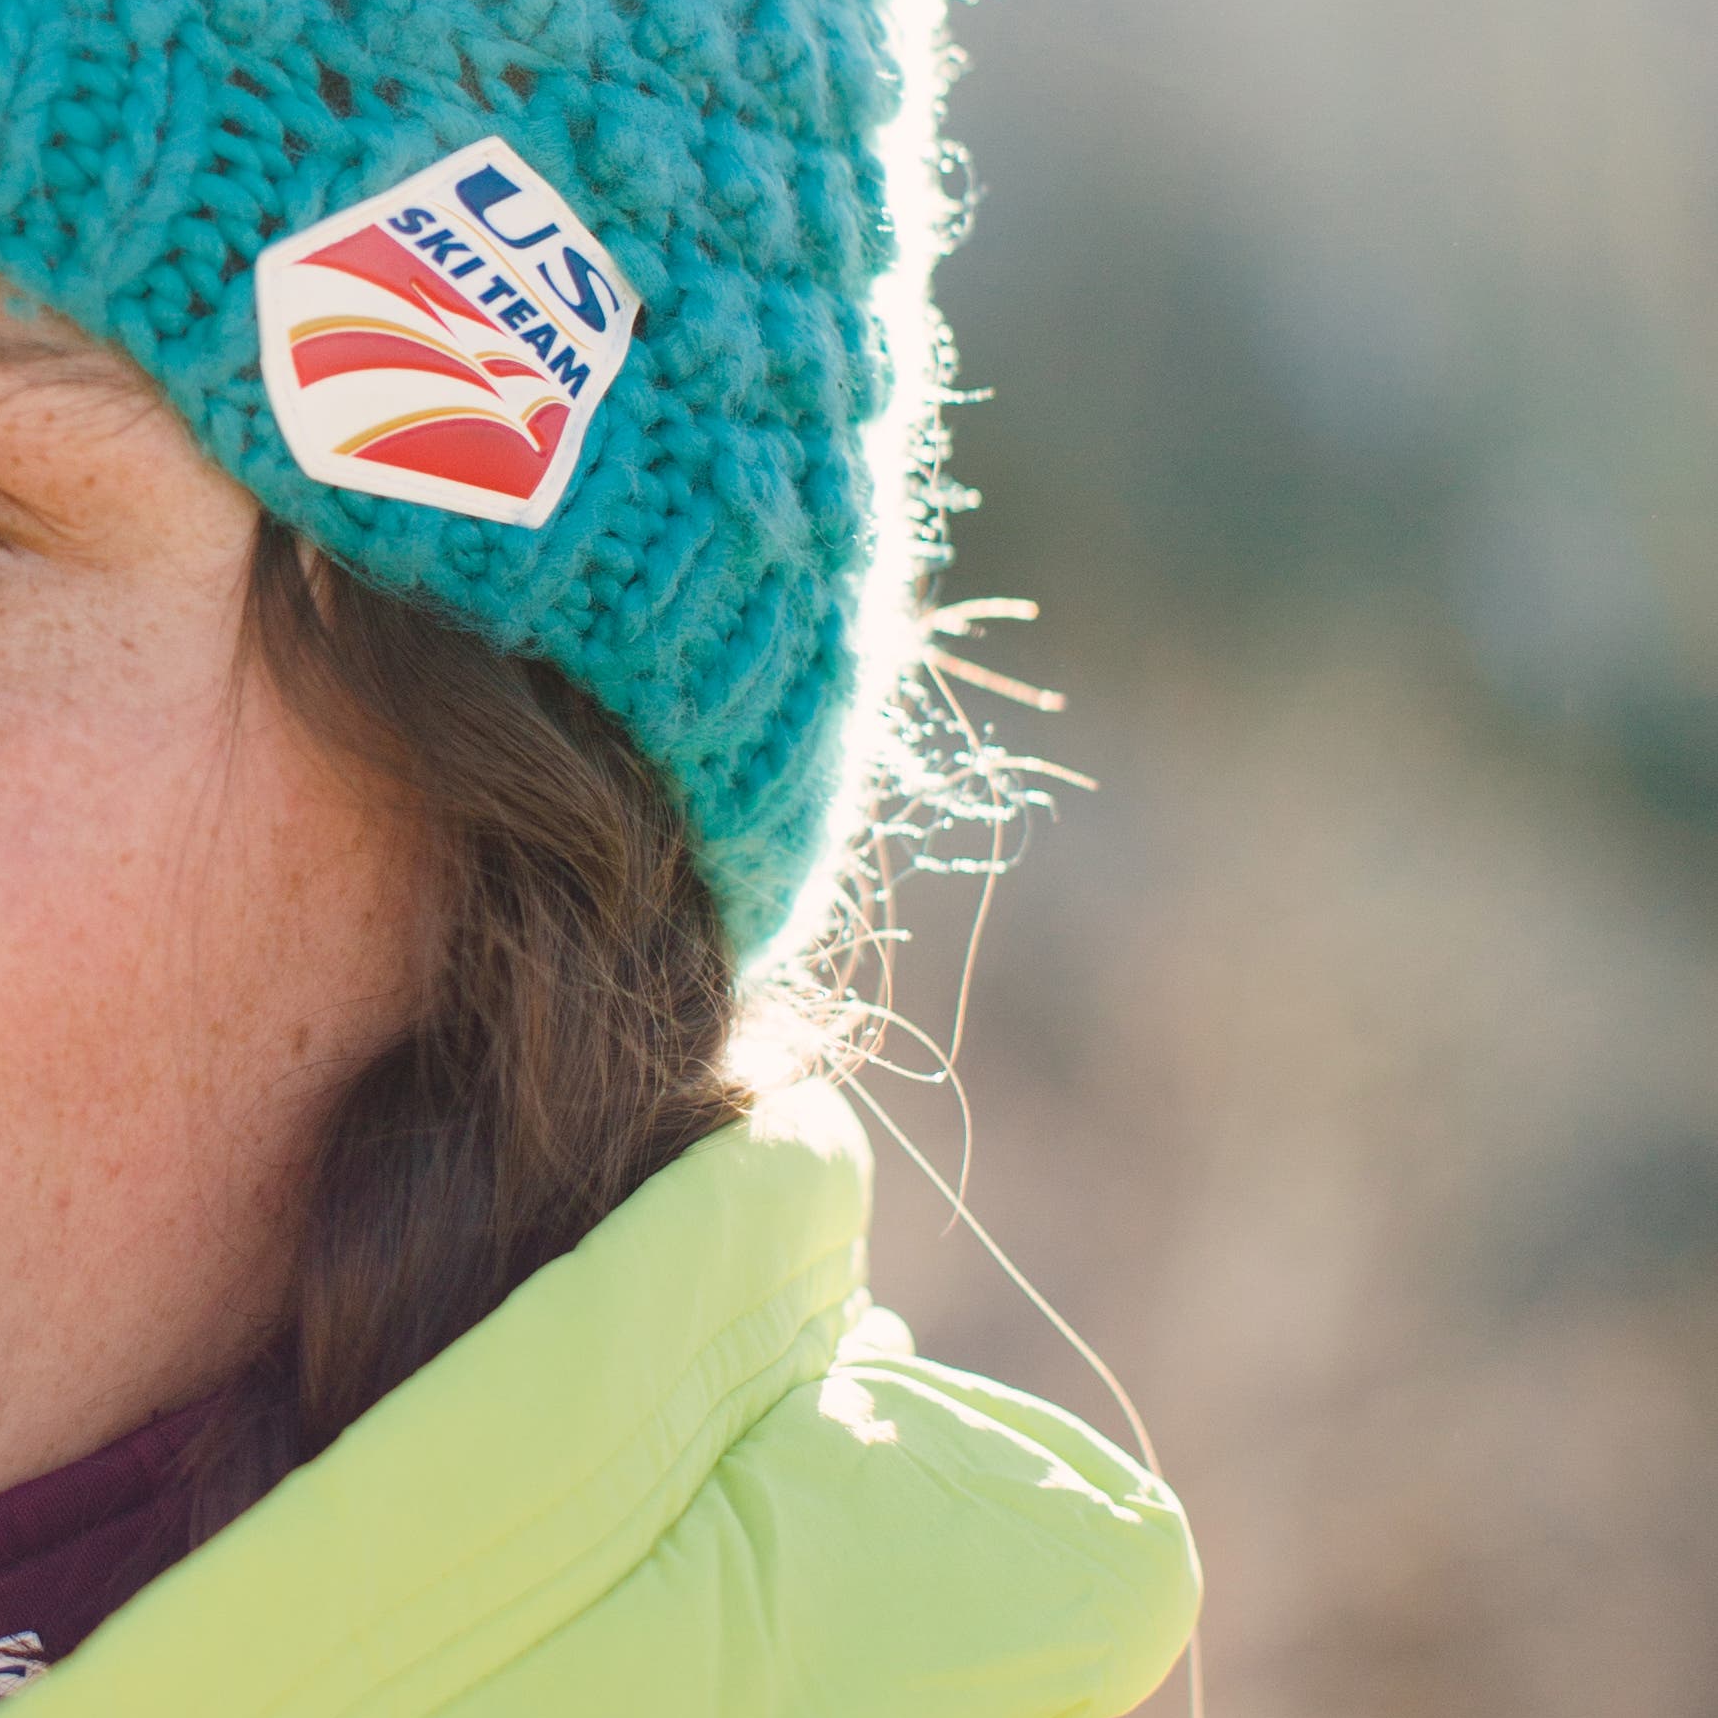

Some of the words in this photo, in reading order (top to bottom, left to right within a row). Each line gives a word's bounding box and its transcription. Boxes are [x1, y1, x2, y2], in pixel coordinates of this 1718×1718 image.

[387, 206, 485, 281] SKI
[477, 275, 592, 401] TEAM
[454, 163, 621, 334] US
